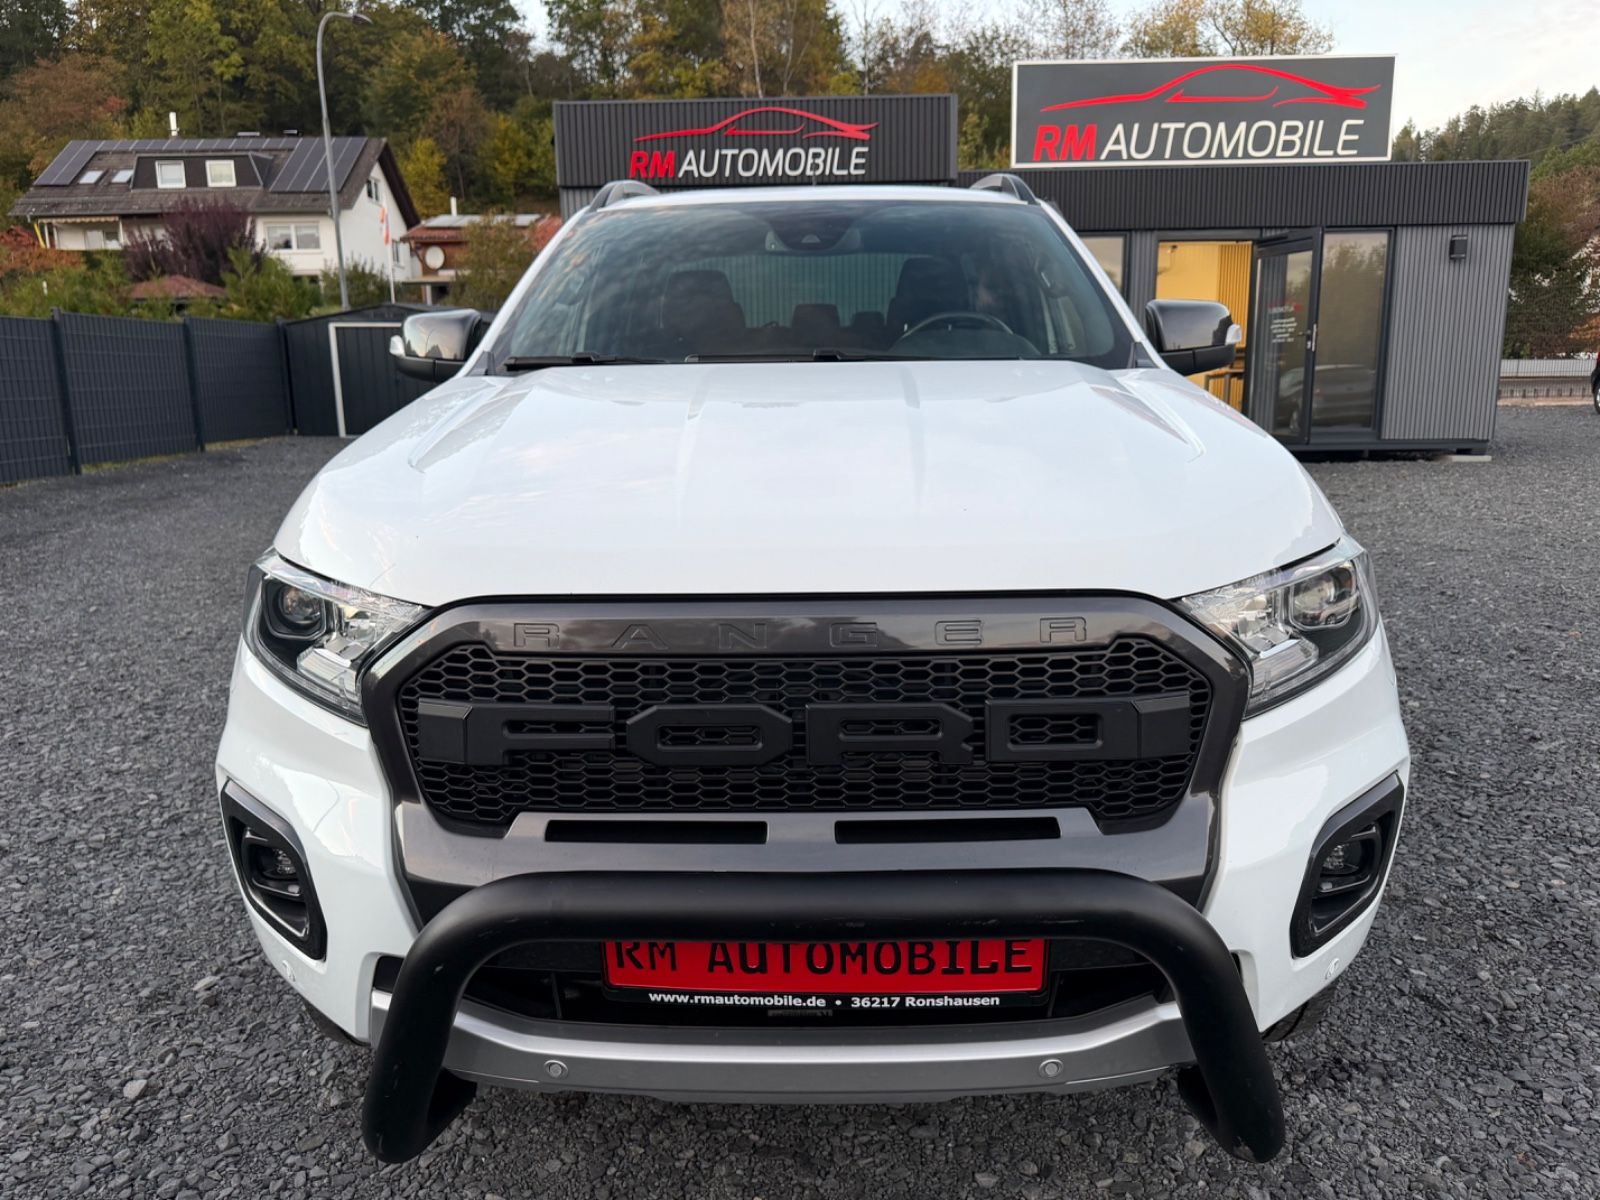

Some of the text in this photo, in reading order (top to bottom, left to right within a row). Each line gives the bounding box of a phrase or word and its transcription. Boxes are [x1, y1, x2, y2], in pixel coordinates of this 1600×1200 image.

[1033, 119, 1365, 161] RM AUTOMOBILE
[629, 146, 869, 178] RM AUTOMOBILE
[512, 616, 1088, 650] RANGER
[460, 700, 1140, 767] FORD
[614, 940, 1033, 975] RM AUTOMOBILE
[648, 992, 1000, 1008] www.rmautomobile.de 36217 Ronshausen
